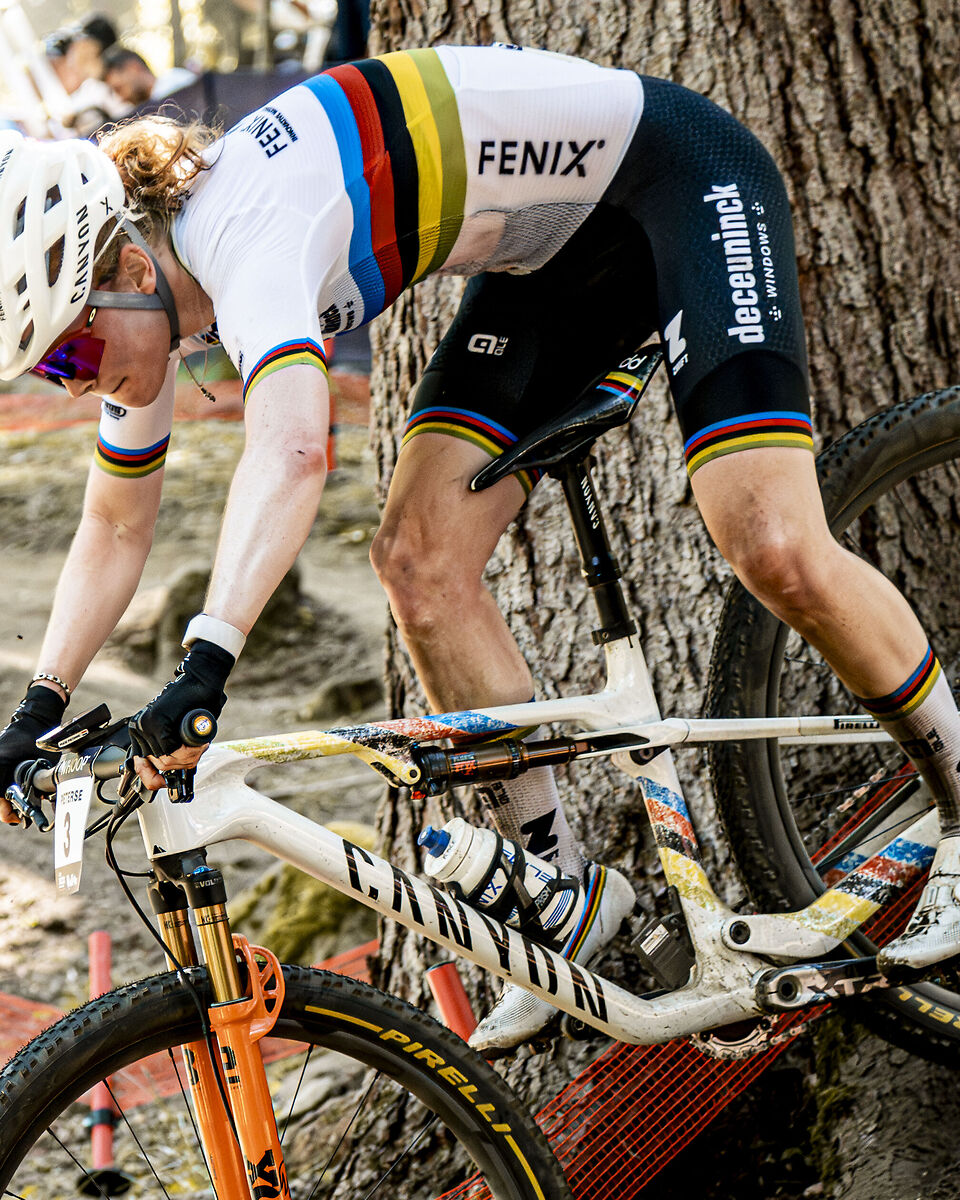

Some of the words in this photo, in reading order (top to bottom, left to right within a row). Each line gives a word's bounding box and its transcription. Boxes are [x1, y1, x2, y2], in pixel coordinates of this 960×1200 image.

[478, 140, 598, 178] FENIX
[70, 204, 90, 305] CANYON
[703, 183, 766, 345] deceuninck
[756, 222, 778, 299] WINDOWS
[63, 811, 71, 858] 3
[343, 838, 609, 1024] CANYON
[379, 1028, 511, 1138] PIRELLI
